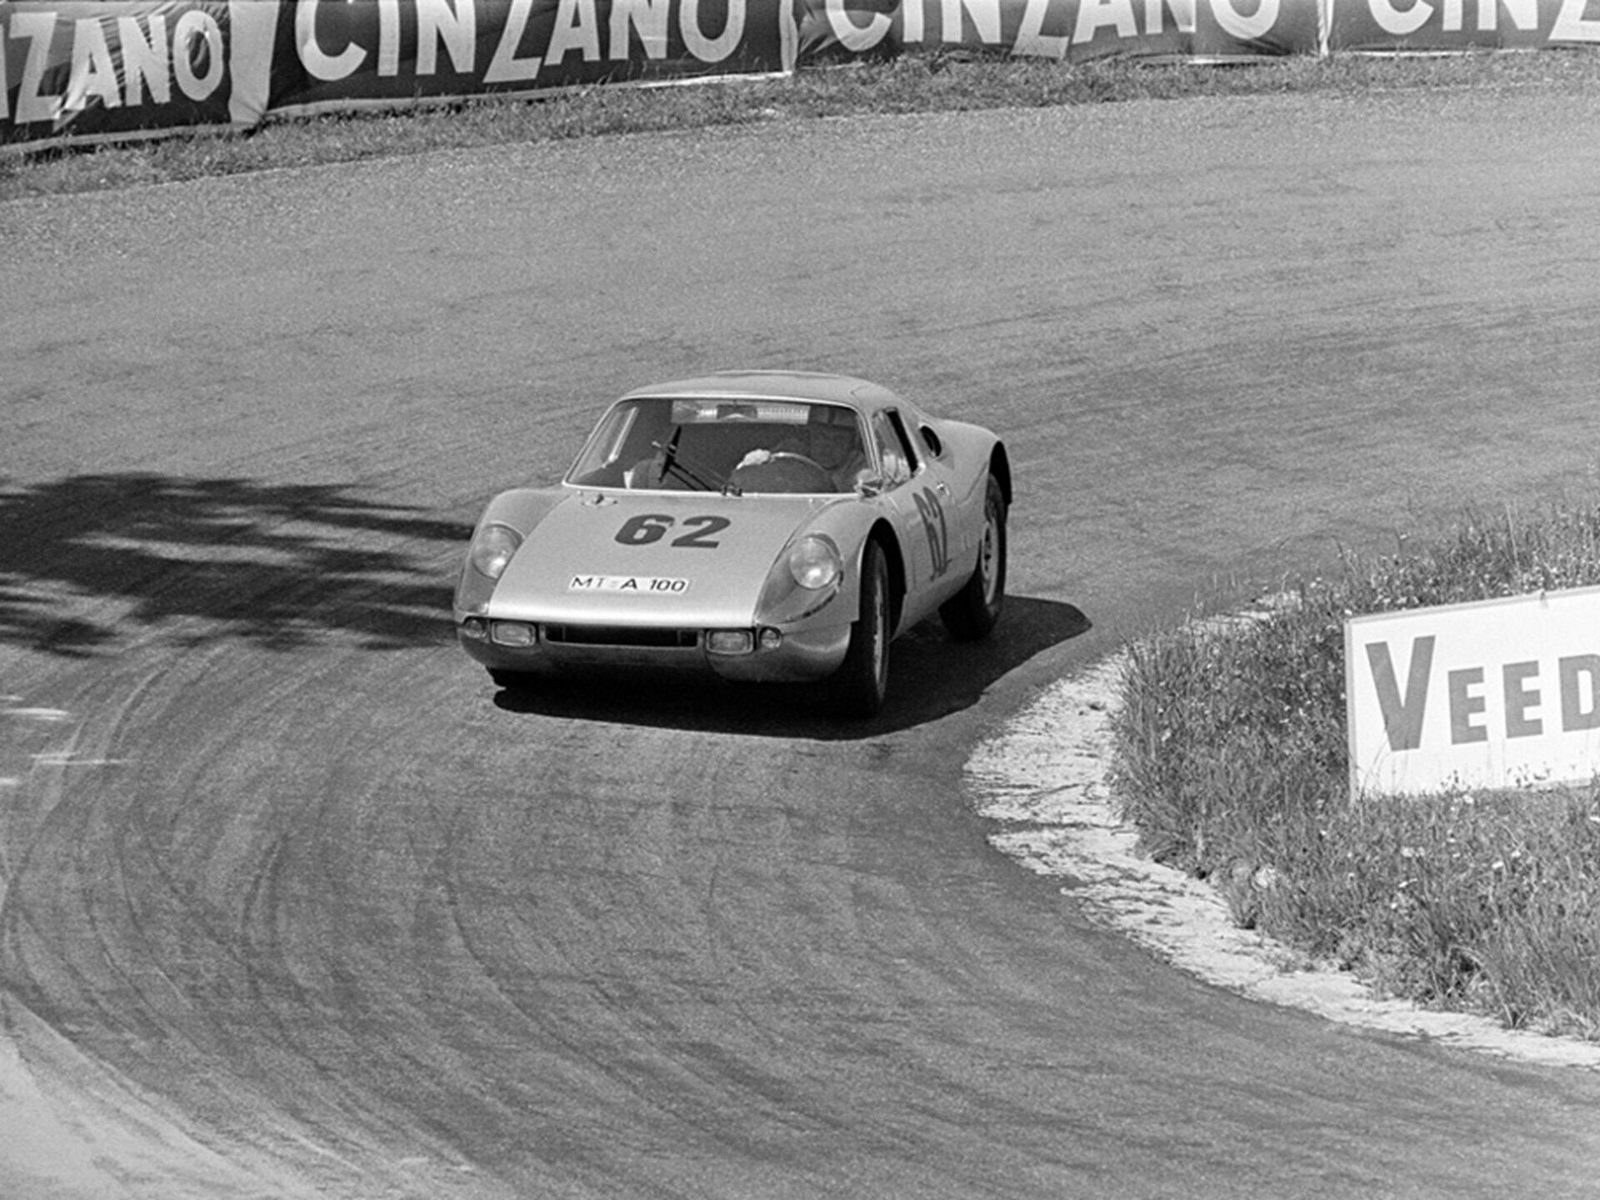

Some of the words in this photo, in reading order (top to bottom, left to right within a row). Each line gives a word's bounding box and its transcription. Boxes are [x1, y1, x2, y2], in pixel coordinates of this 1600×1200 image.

[0, 10, 224, 124] ZANO
[295, 0, 745, 83] CINZANO
[614, 514, 732, 549] 62
[649, 578, 686, 592] 100
